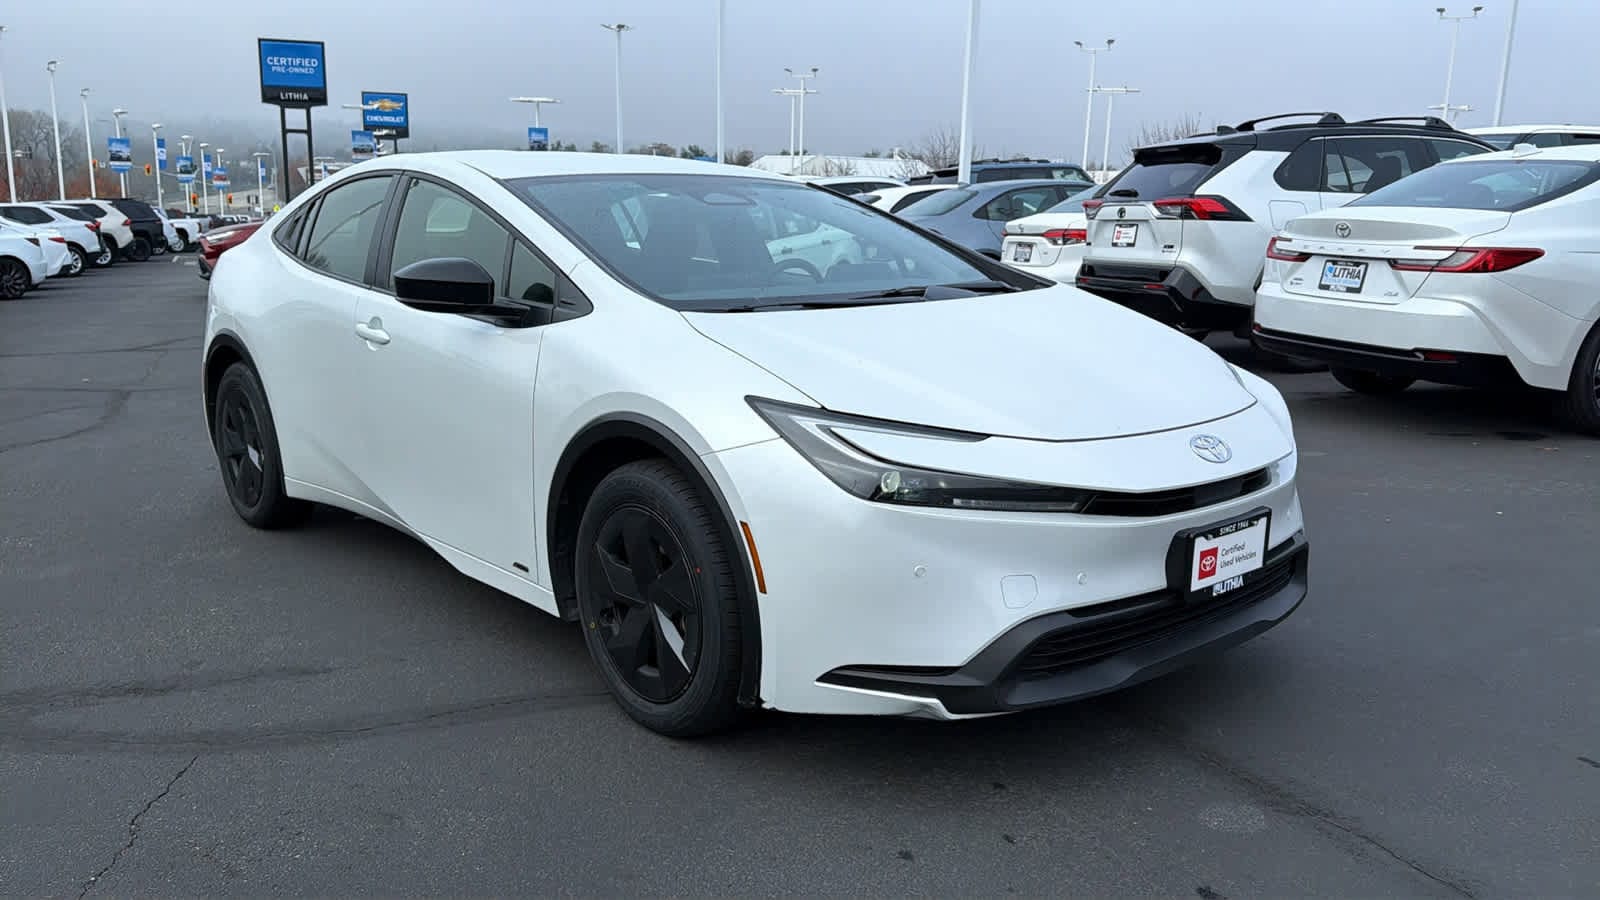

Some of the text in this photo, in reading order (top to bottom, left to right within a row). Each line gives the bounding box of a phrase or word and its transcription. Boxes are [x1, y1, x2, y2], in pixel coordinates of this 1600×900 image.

[266, 56, 318, 67] CERTIFIED
[271, 66, 315, 74] PRE-OWNED
[280, 92, 309, 100] LITHIA
[1332, 266, 1361, 280] LITHIA
[1220, 541, 1246, 557] Certified
[1220, 551, 1257, 568] Used Vehicles
